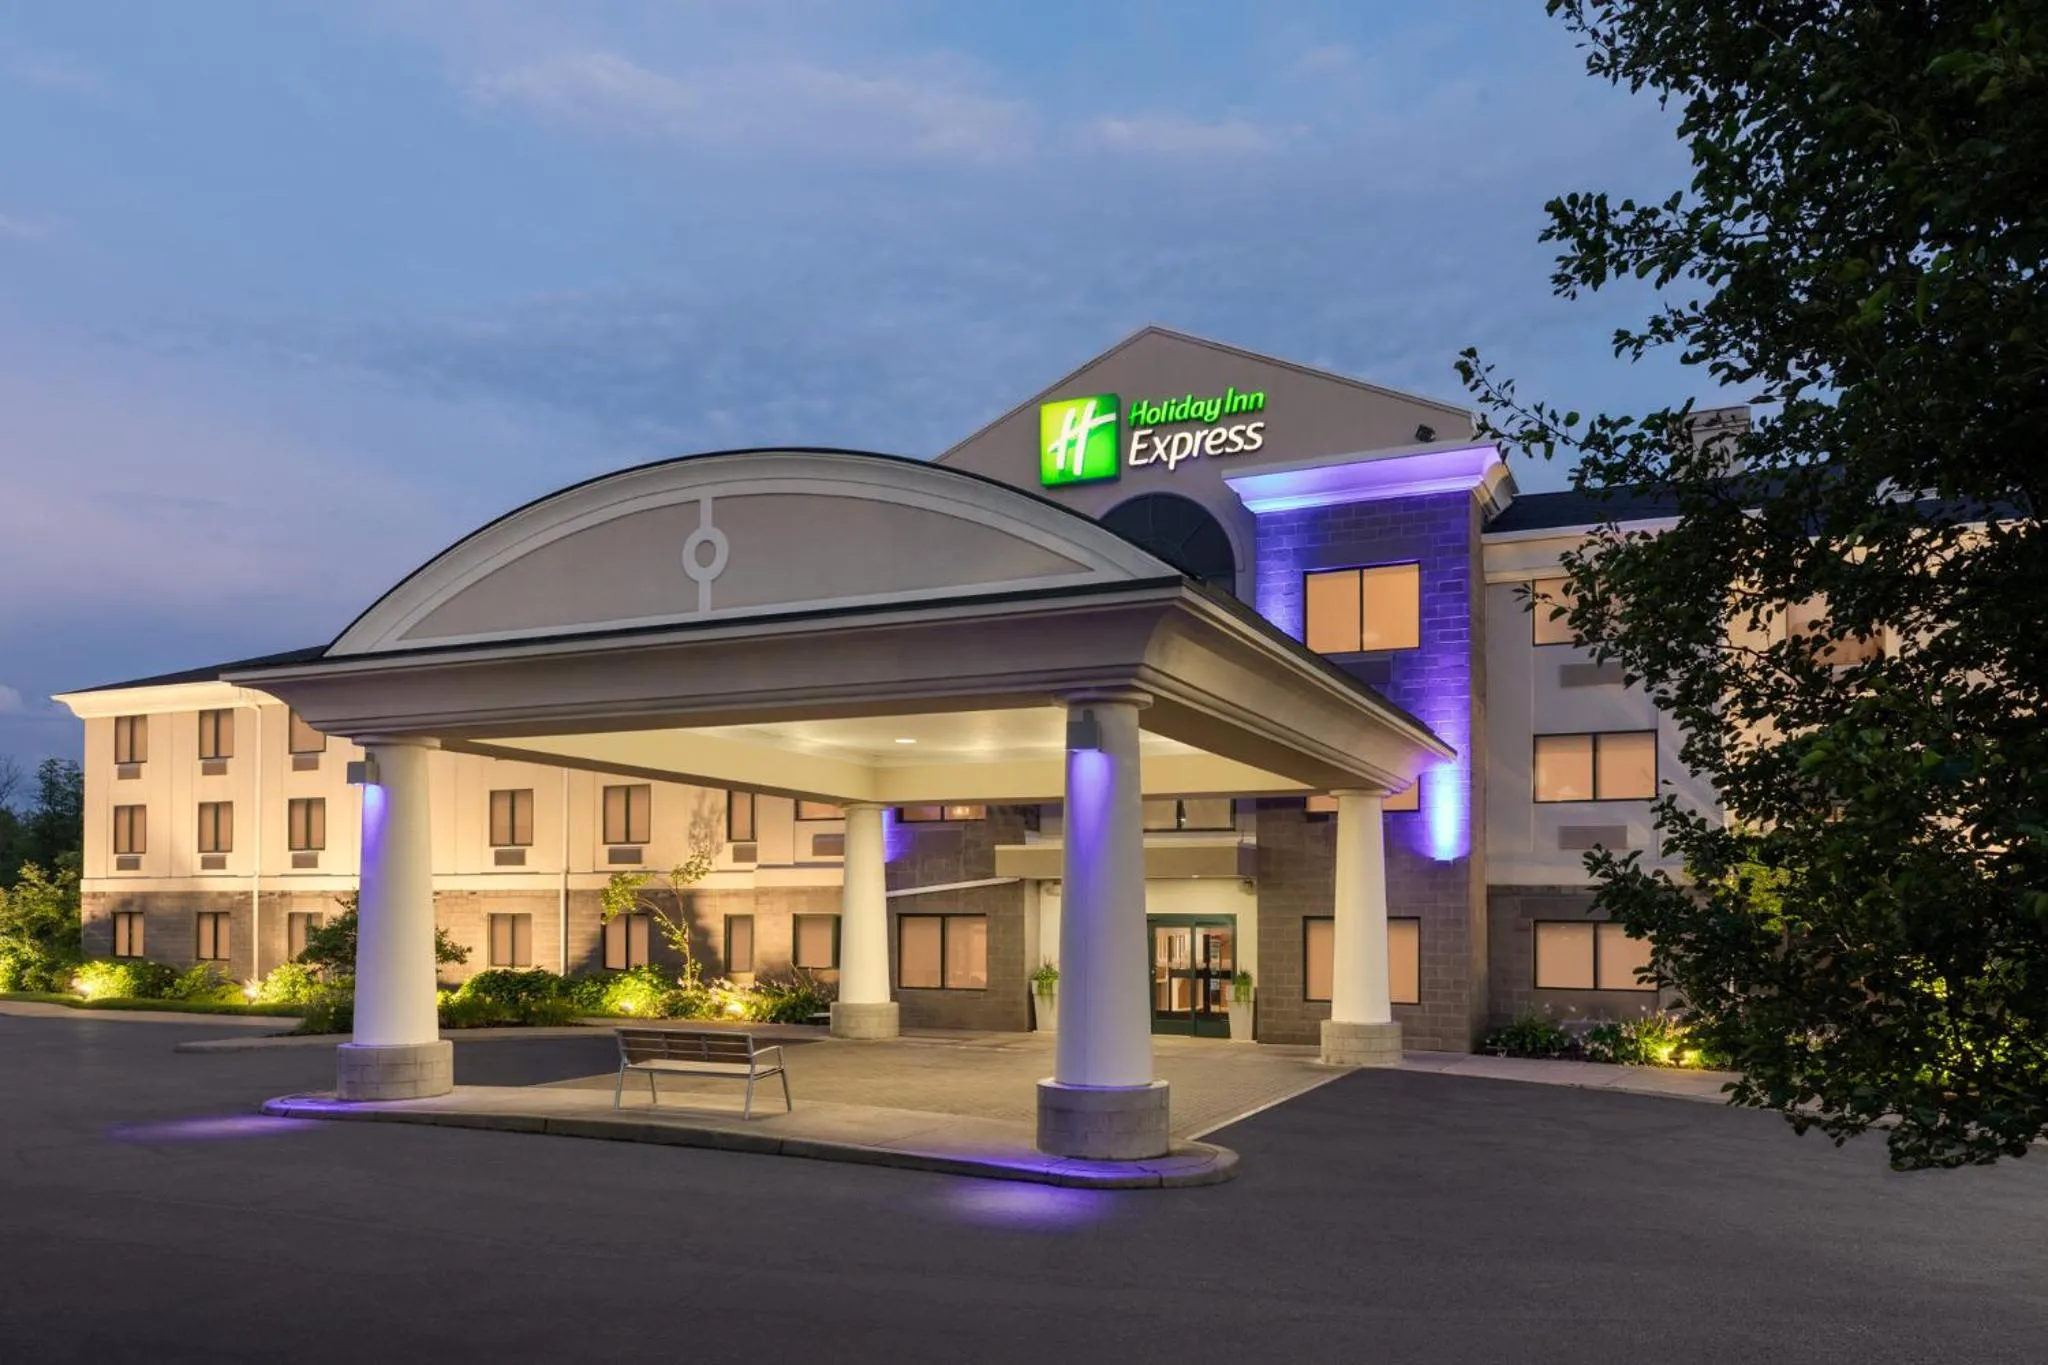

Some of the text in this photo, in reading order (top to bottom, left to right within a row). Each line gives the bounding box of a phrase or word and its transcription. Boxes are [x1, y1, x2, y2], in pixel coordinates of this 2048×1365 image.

[1128, 387, 1265, 426] Holiday Inn
[1047, 400, 1117, 476] H
[1128, 421, 1265, 471] Express
